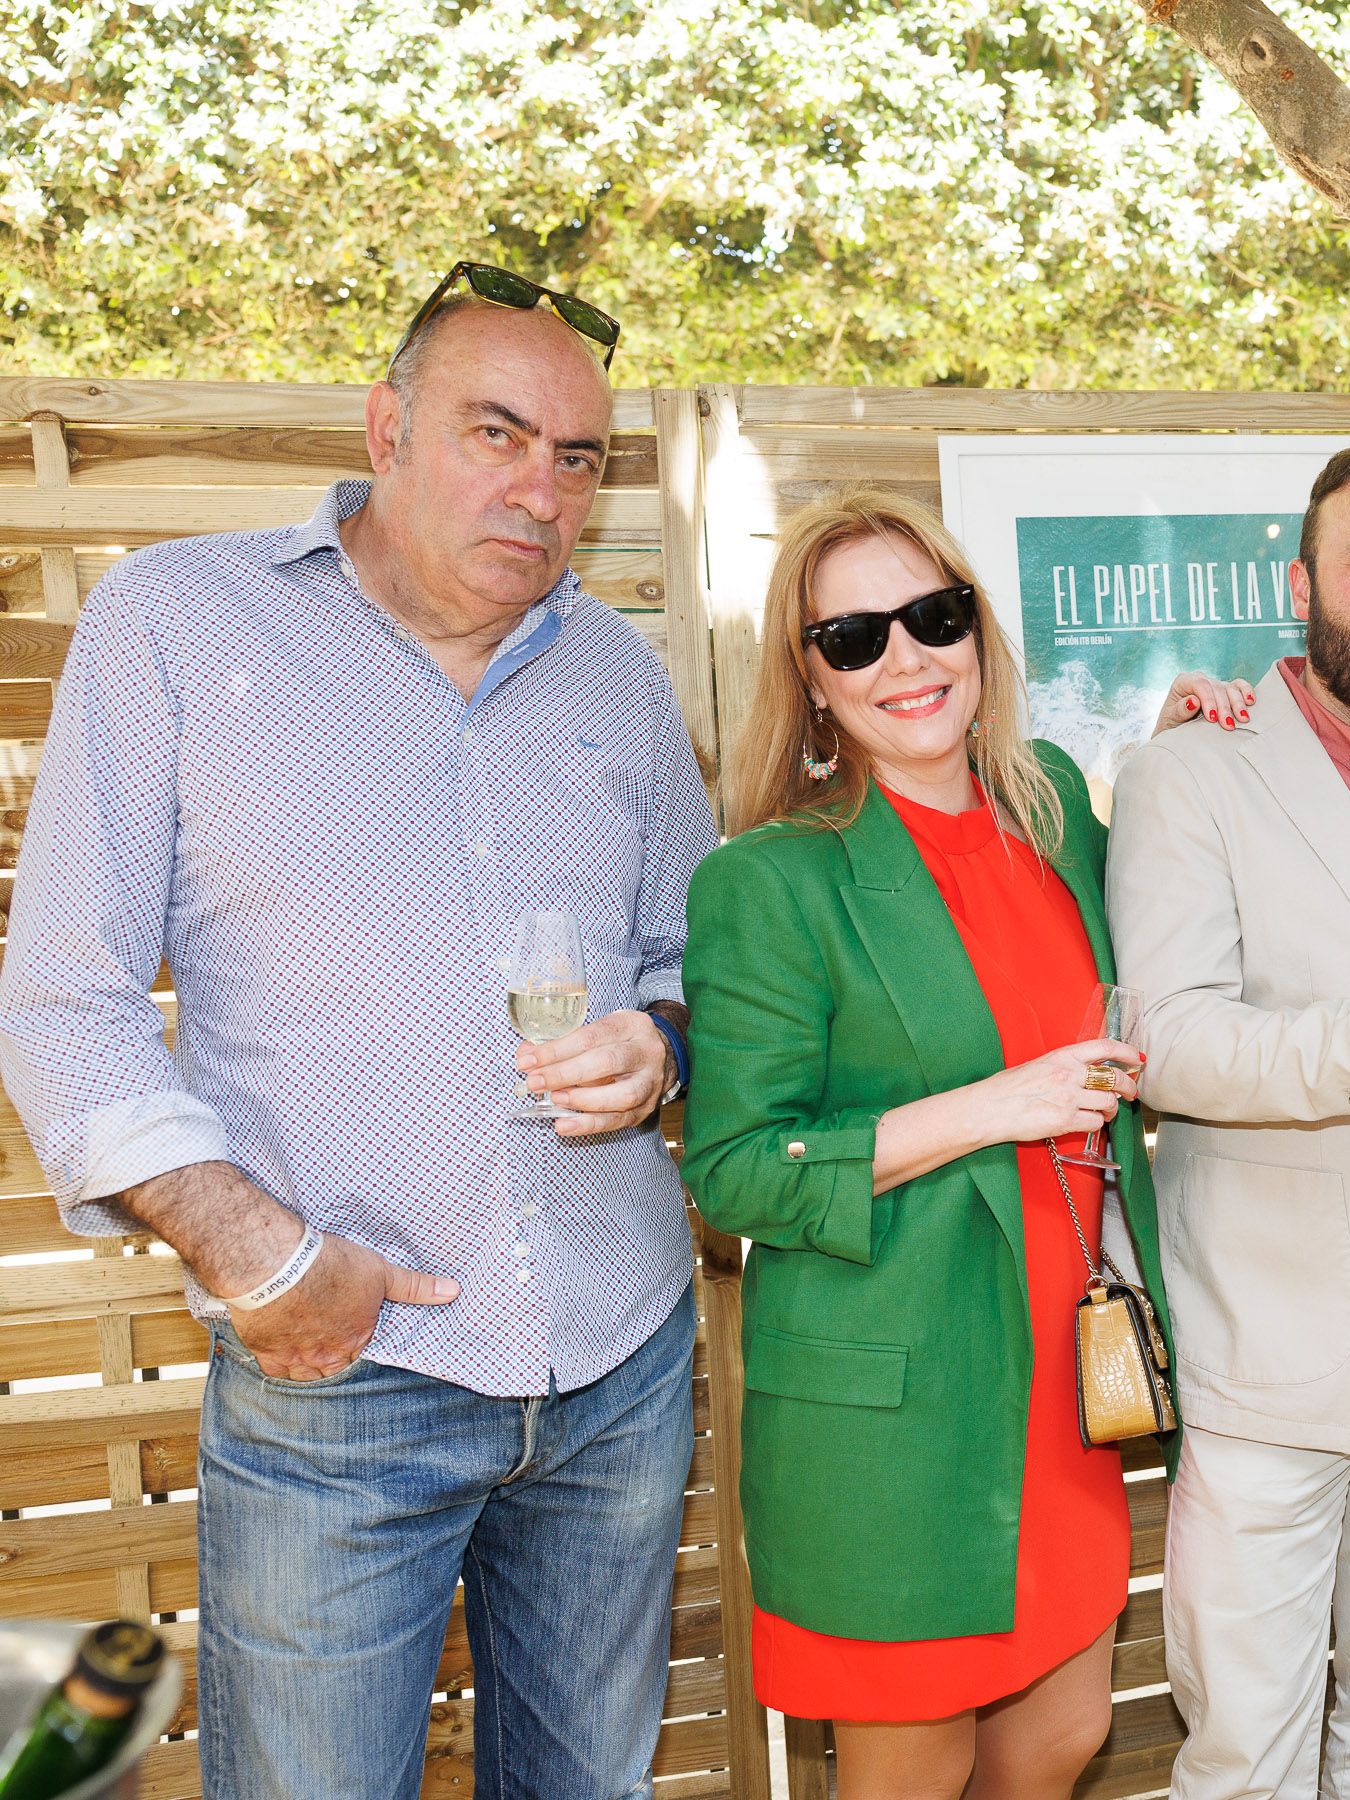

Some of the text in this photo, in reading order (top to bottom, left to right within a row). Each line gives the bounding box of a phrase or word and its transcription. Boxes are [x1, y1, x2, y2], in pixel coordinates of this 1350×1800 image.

[1053, 559, 1300, 626] EL PAPEL DE LA V
[250, 1236, 318, 1303] lavozdelsur.es
